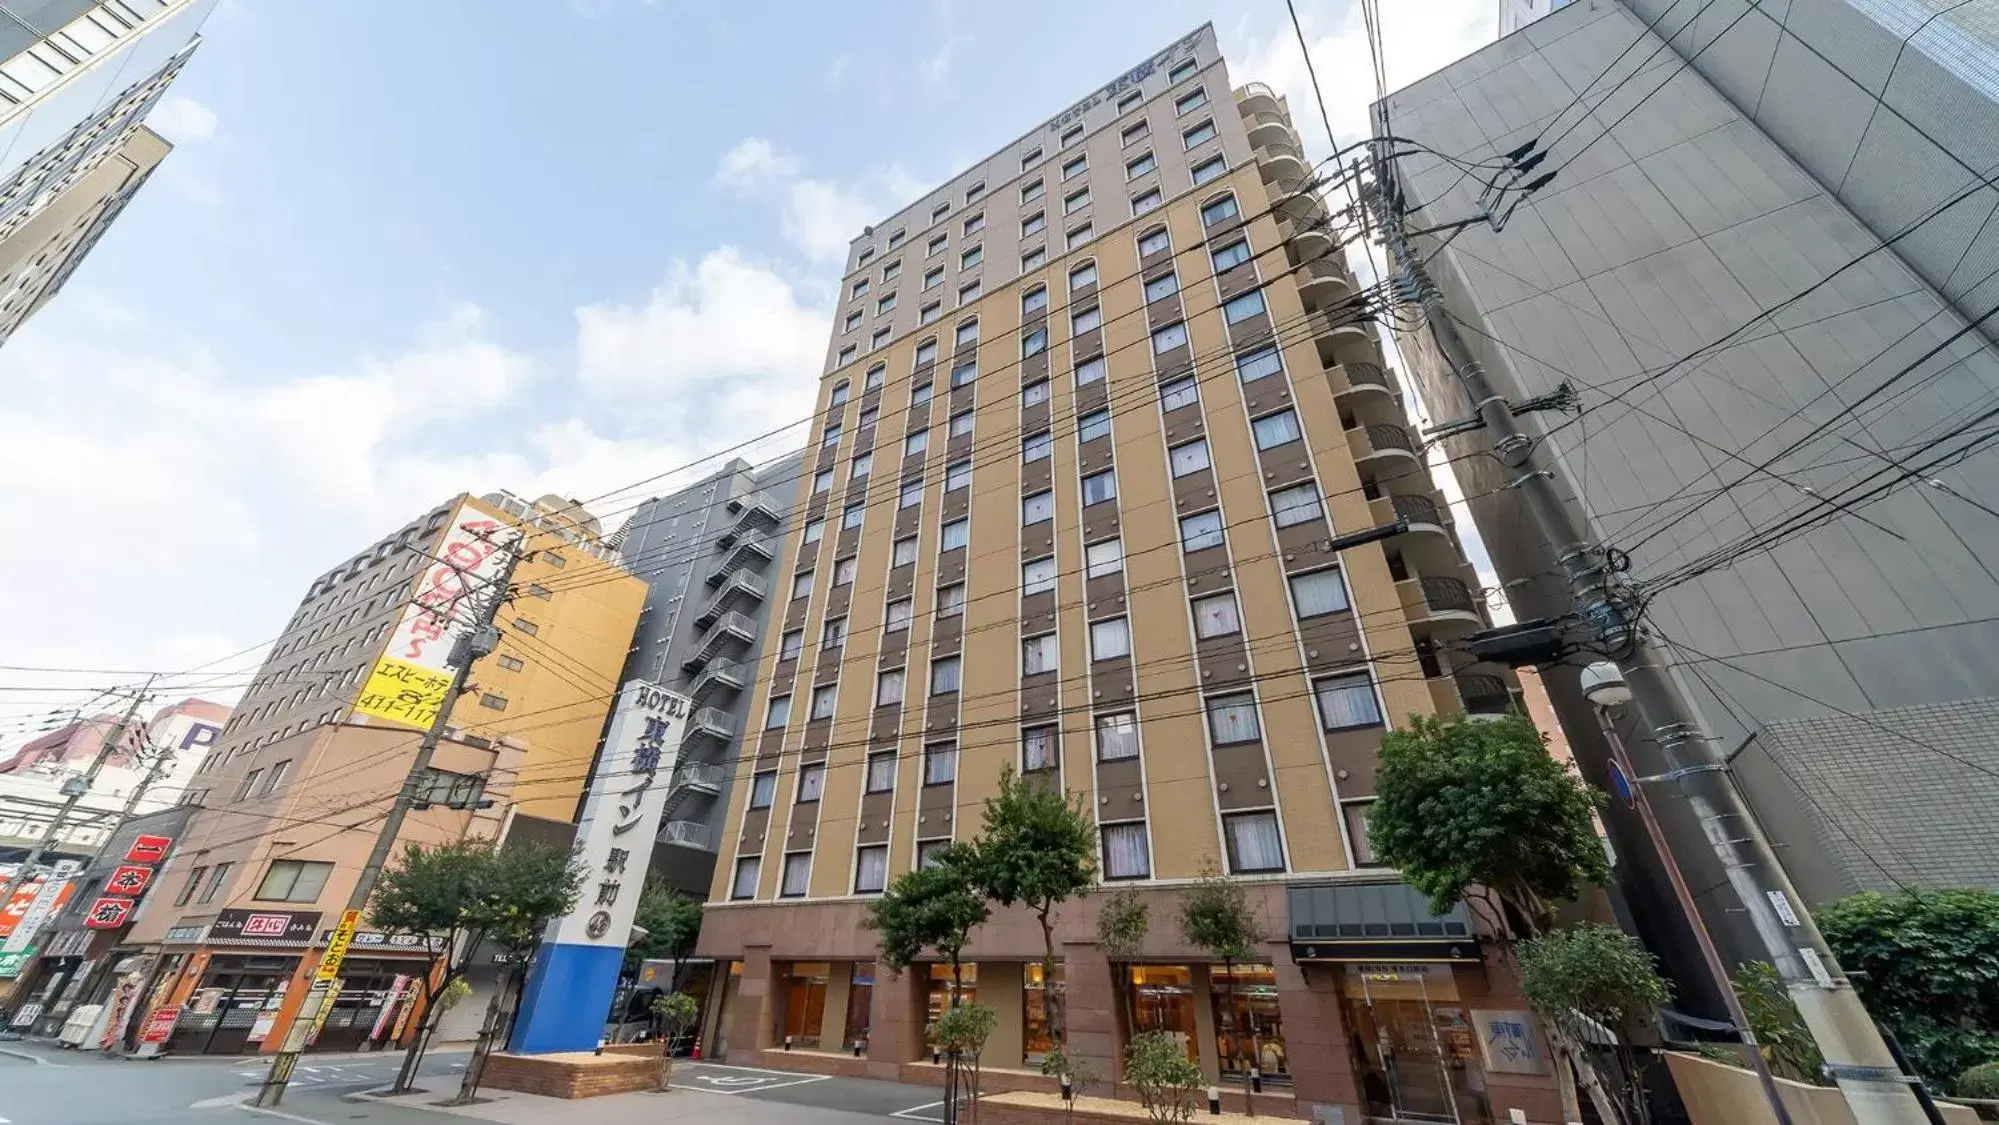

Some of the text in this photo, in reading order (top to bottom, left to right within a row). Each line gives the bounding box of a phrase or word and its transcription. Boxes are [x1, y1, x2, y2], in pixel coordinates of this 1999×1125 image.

[360, 694, 437, 723] 411-117
[635, 685, 686, 719] HOTEL
[179, 722, 222, 750] P
[594, 715, 671, 909] 東横イン 駅前
